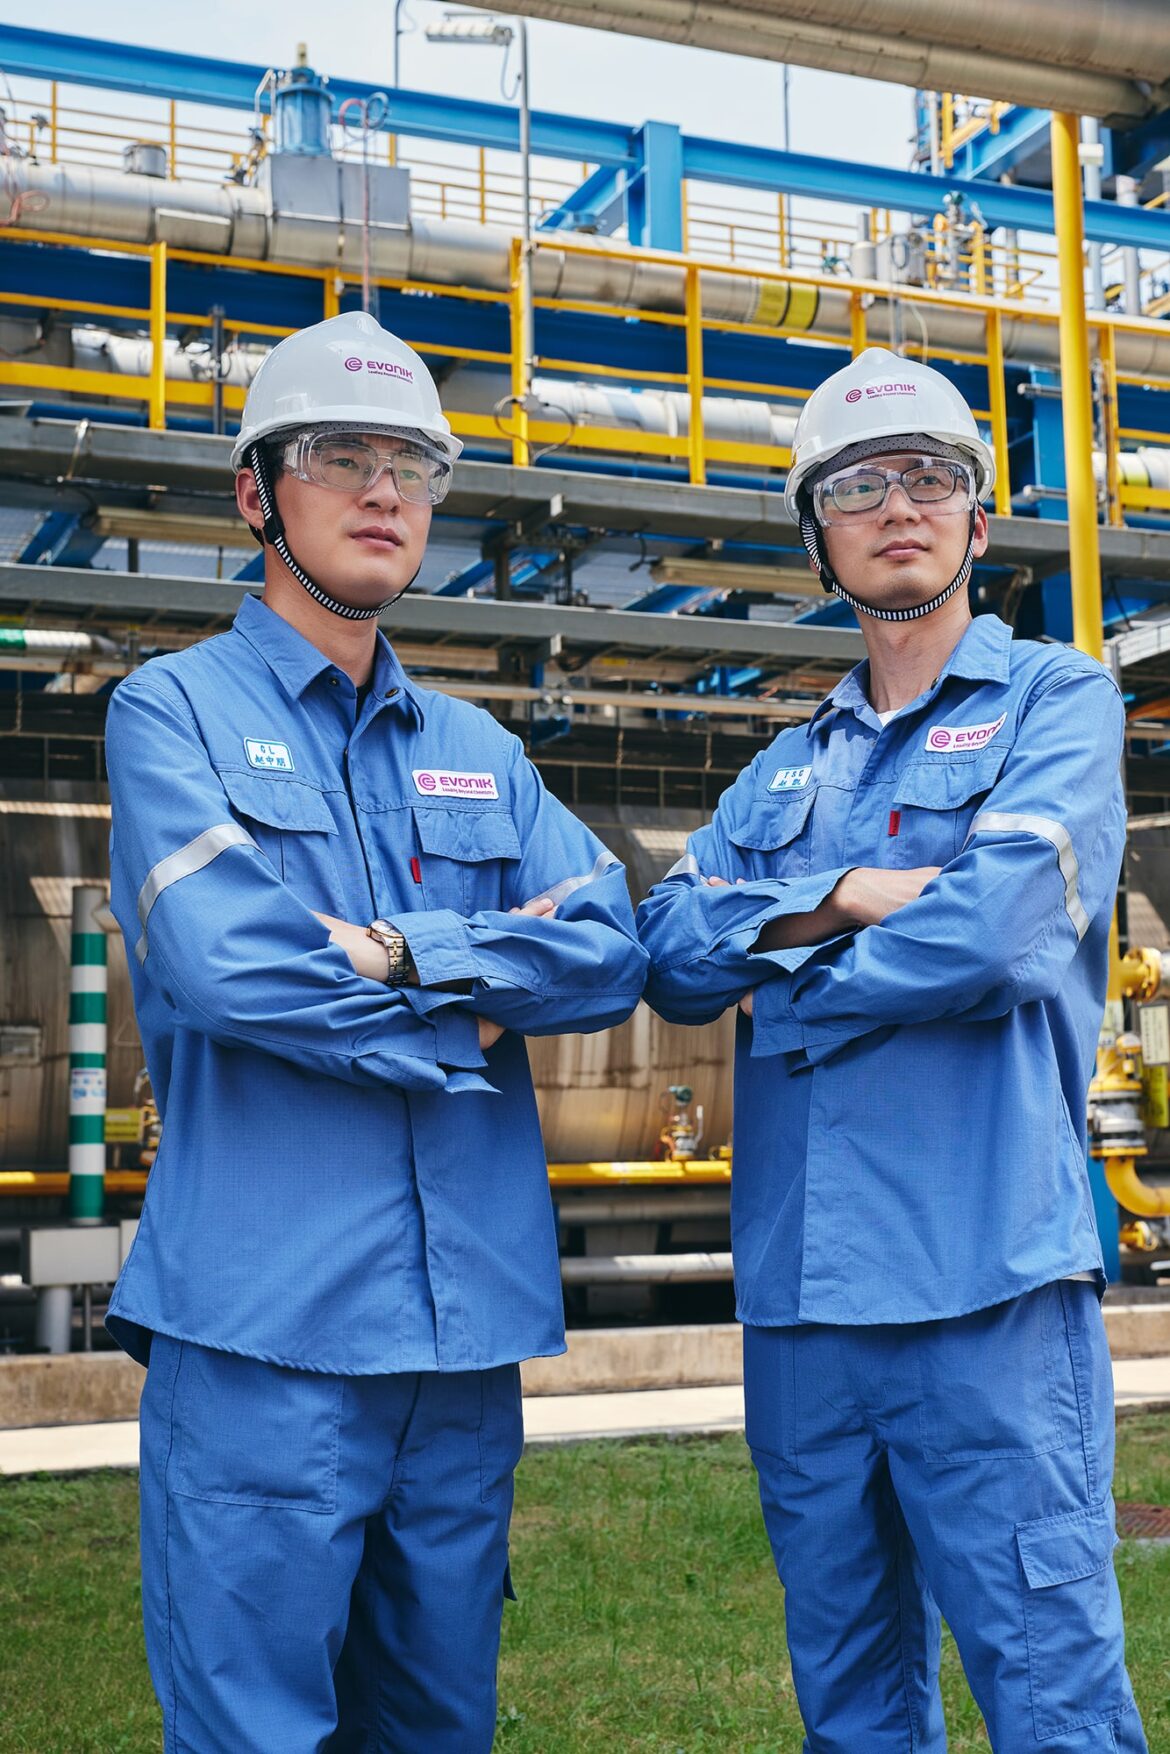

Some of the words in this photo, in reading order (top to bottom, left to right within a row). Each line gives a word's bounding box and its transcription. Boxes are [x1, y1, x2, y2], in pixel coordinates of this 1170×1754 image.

[367, 361, 414, 380] EVONIK
[866, 383, 917, 395] EVONIK
[439, 776, 494, 789] EVONIK
